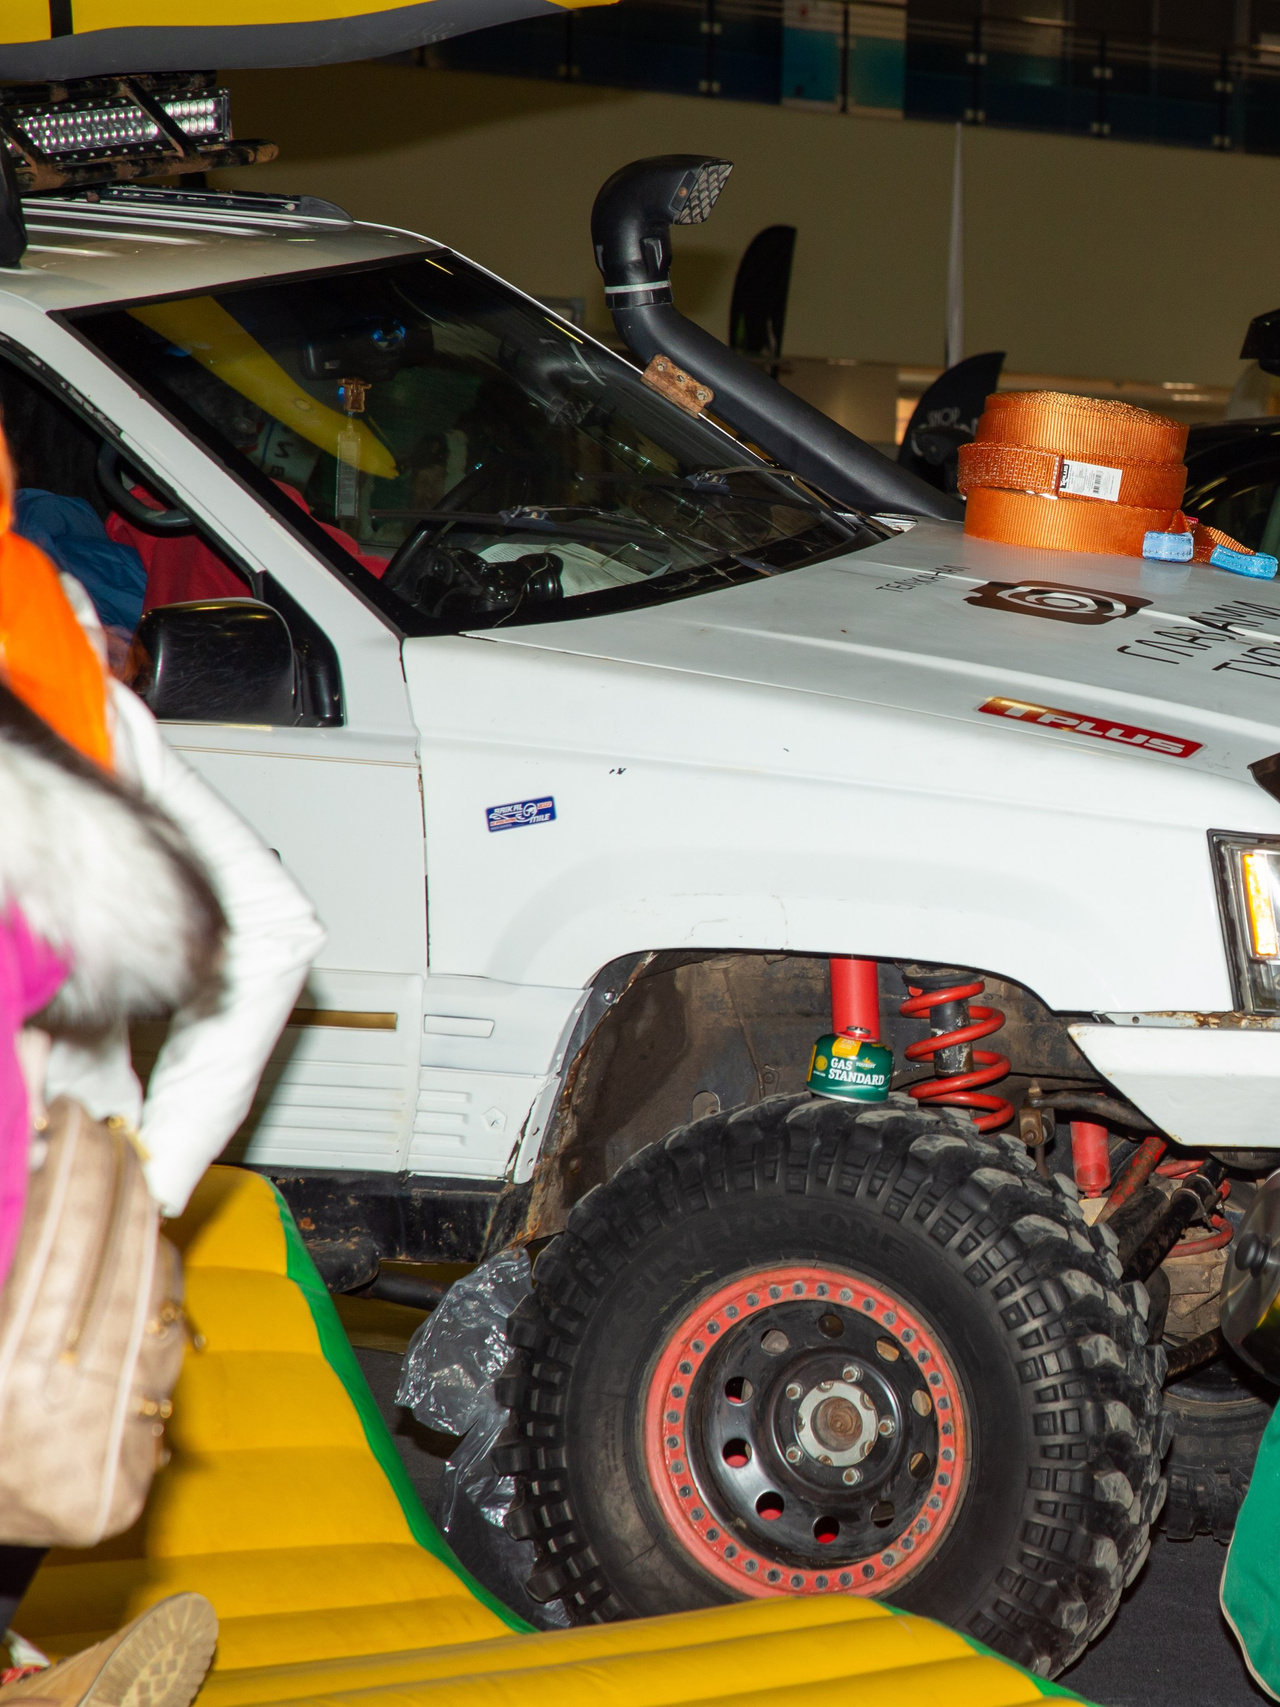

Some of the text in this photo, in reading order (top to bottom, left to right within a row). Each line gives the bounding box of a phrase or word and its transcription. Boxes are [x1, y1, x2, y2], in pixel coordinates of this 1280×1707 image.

[529, 813, 551, 824] MILE
[830, 1057, 853, 1071] GAS
[828, 1068, 885, 1086] STANDARD
